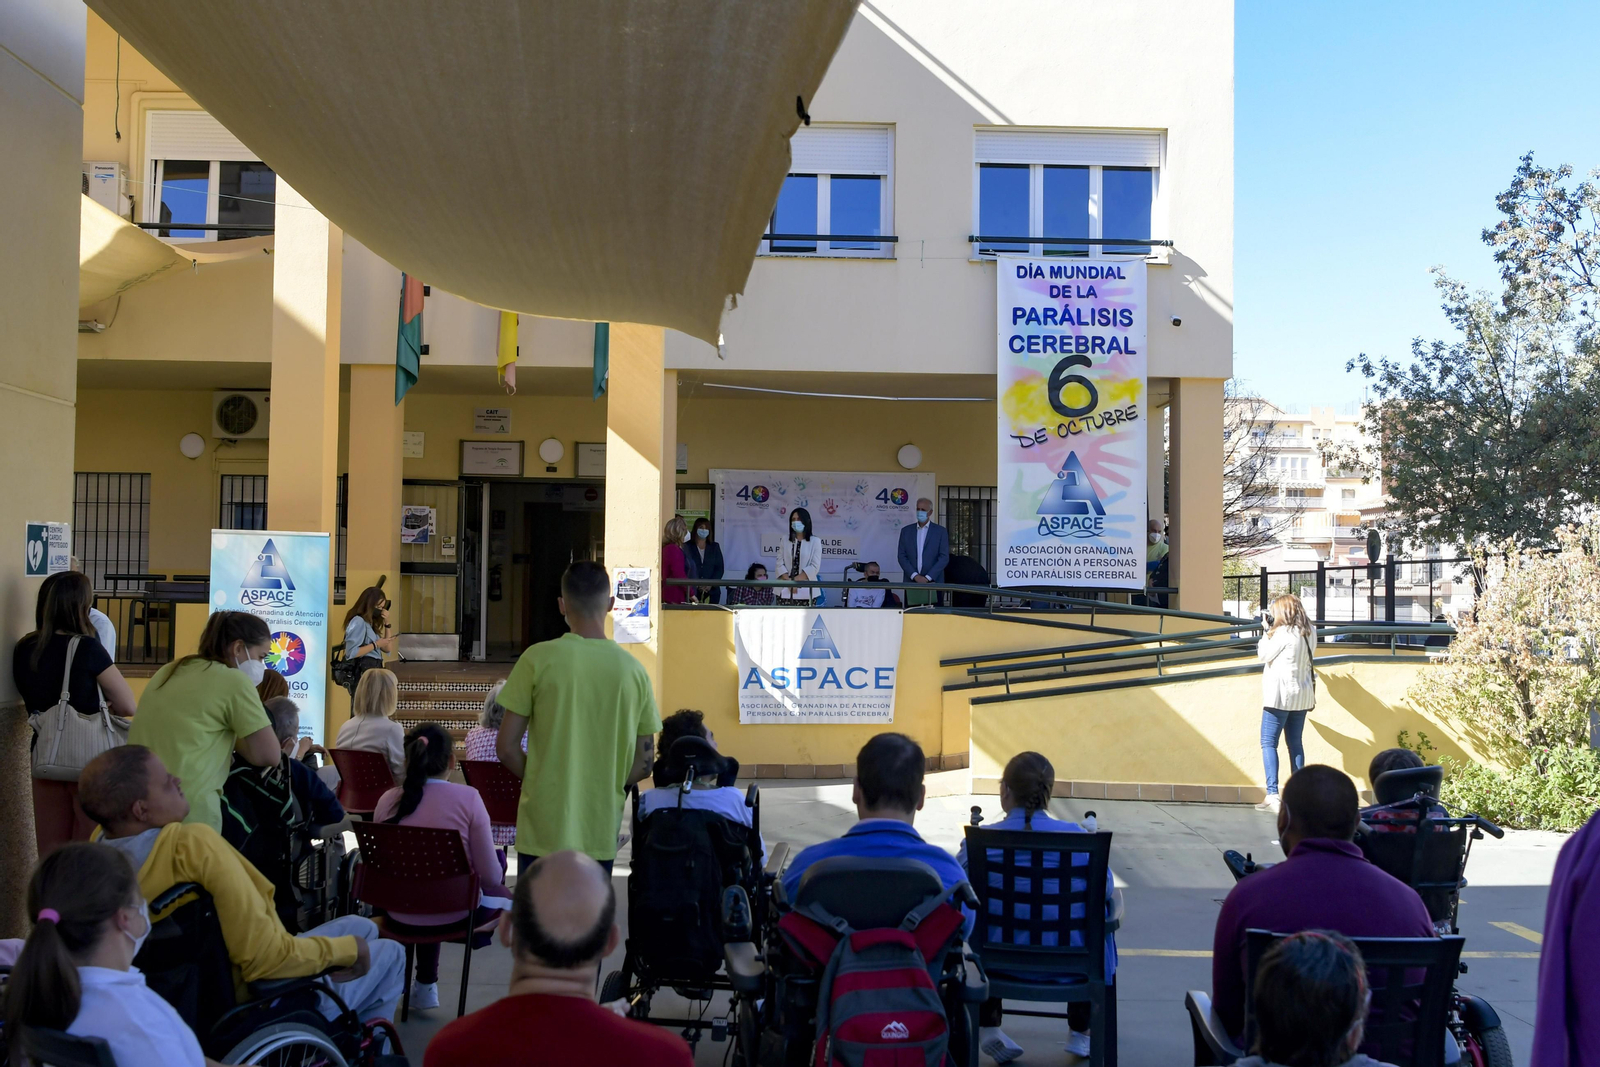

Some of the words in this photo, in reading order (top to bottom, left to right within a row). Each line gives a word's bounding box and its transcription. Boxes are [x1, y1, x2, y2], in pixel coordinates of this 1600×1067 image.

[1016, 263, 1045, 279] DÍA
[1050, 265, 1126, 280] MUNDIAL
[1050, 285, 1072, 298] DE
[1077, 285, 1097, 298] LA
[1012, 304, 1133, 327] PARÁLISIS
[1009, 334, 1136, 354] CEREBRAL
[1048, 355, 1098, 418] 6
[1010, 428, 1048, 448] DE
[1057, 404, 1138, 438] OCTUBRE
[1038, 517, 1104, 533] ASPACE
[1008, 545, 1071, 555] ASOCIACIÓN
[1074, 546, 1133, 555] GRANADINA
[1005, 558, 1018, 566] DE
[1020, 557, 1071, 566] ATENCIÓN
[1083, 558, 1137, 567] PERSONAS
[1006, 570, 1028, 579] CON
[1031, 569, 1082, 579] PARÁLISIS
[1084, 570, 1137, 579] CEREBRAL
[241, 590, 294, 603] ASPACE
[742, 667, 895, 690] ASPACE
